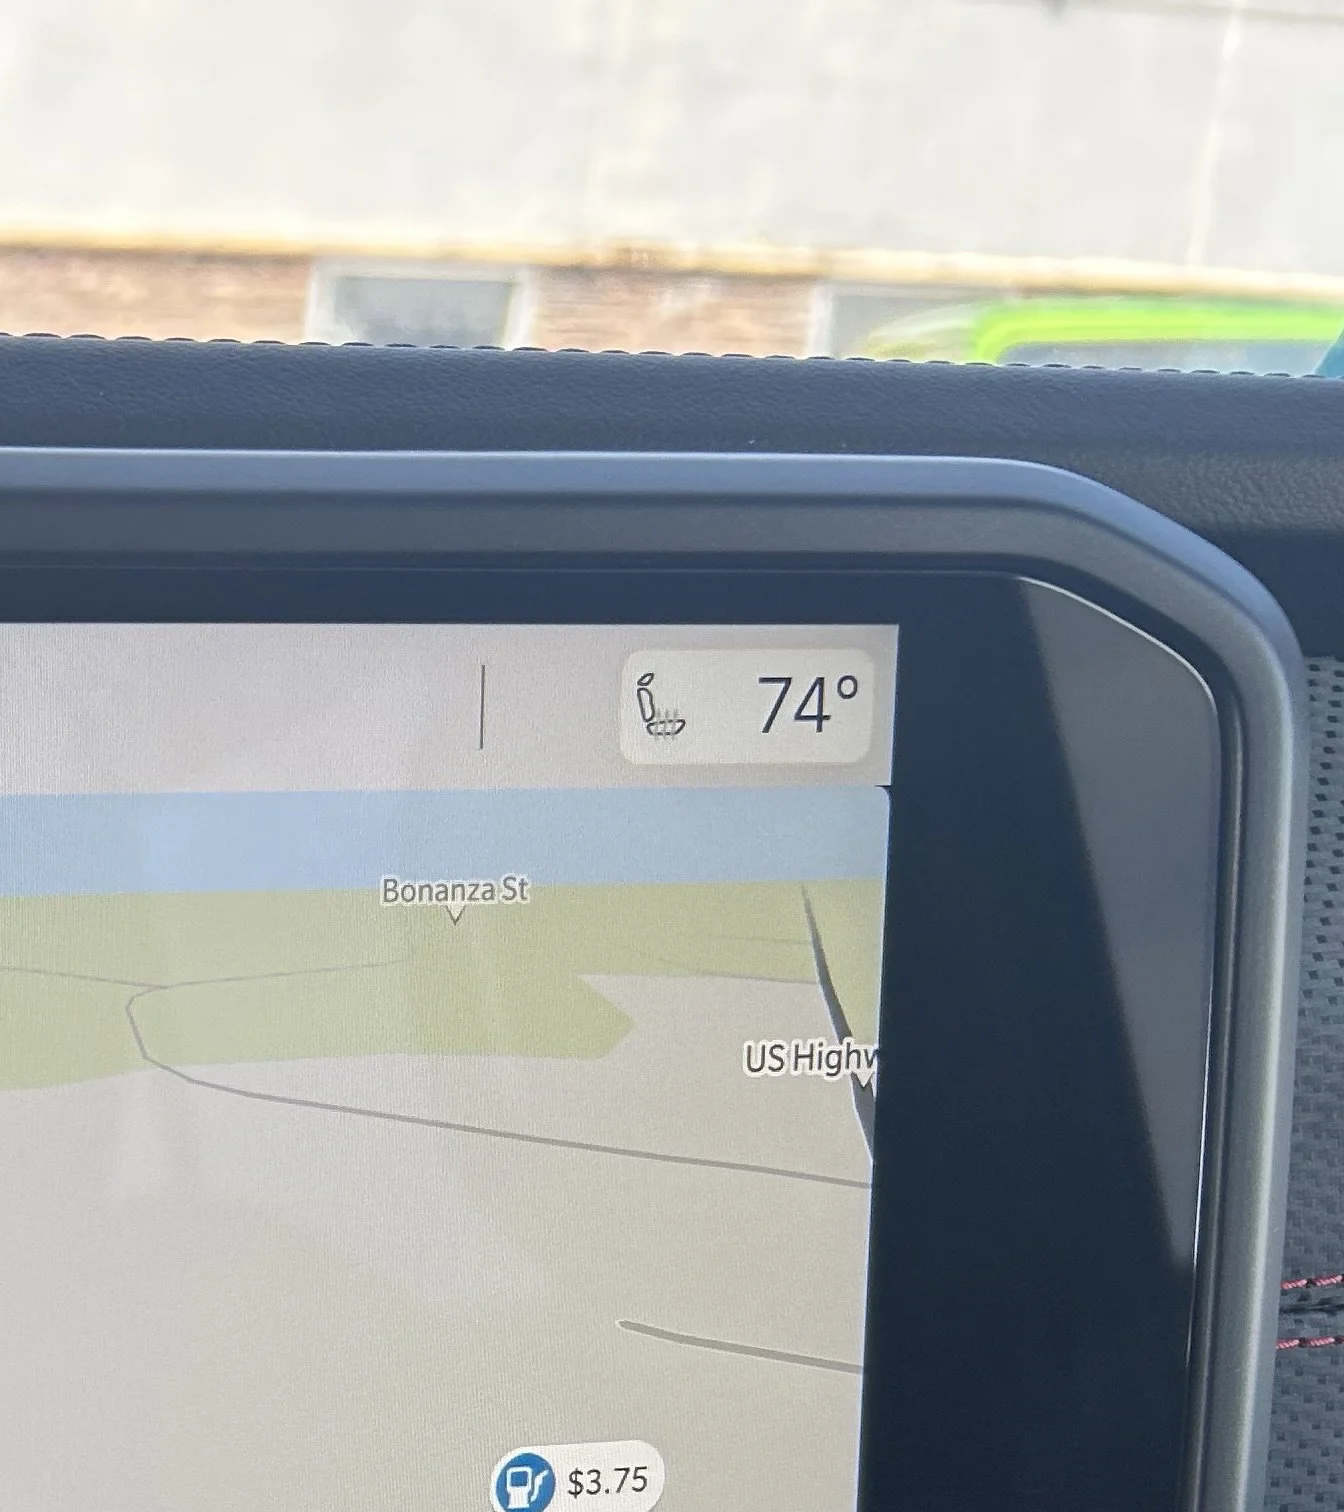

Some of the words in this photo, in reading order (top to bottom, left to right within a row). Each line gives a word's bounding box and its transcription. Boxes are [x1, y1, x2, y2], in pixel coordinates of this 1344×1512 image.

[383, 878, 496, 903] Bonanza
[502, 877, 528, 901] St
[746, 1044, 785, 1072] US
[568, 1467, 647, 1497] $3.75
